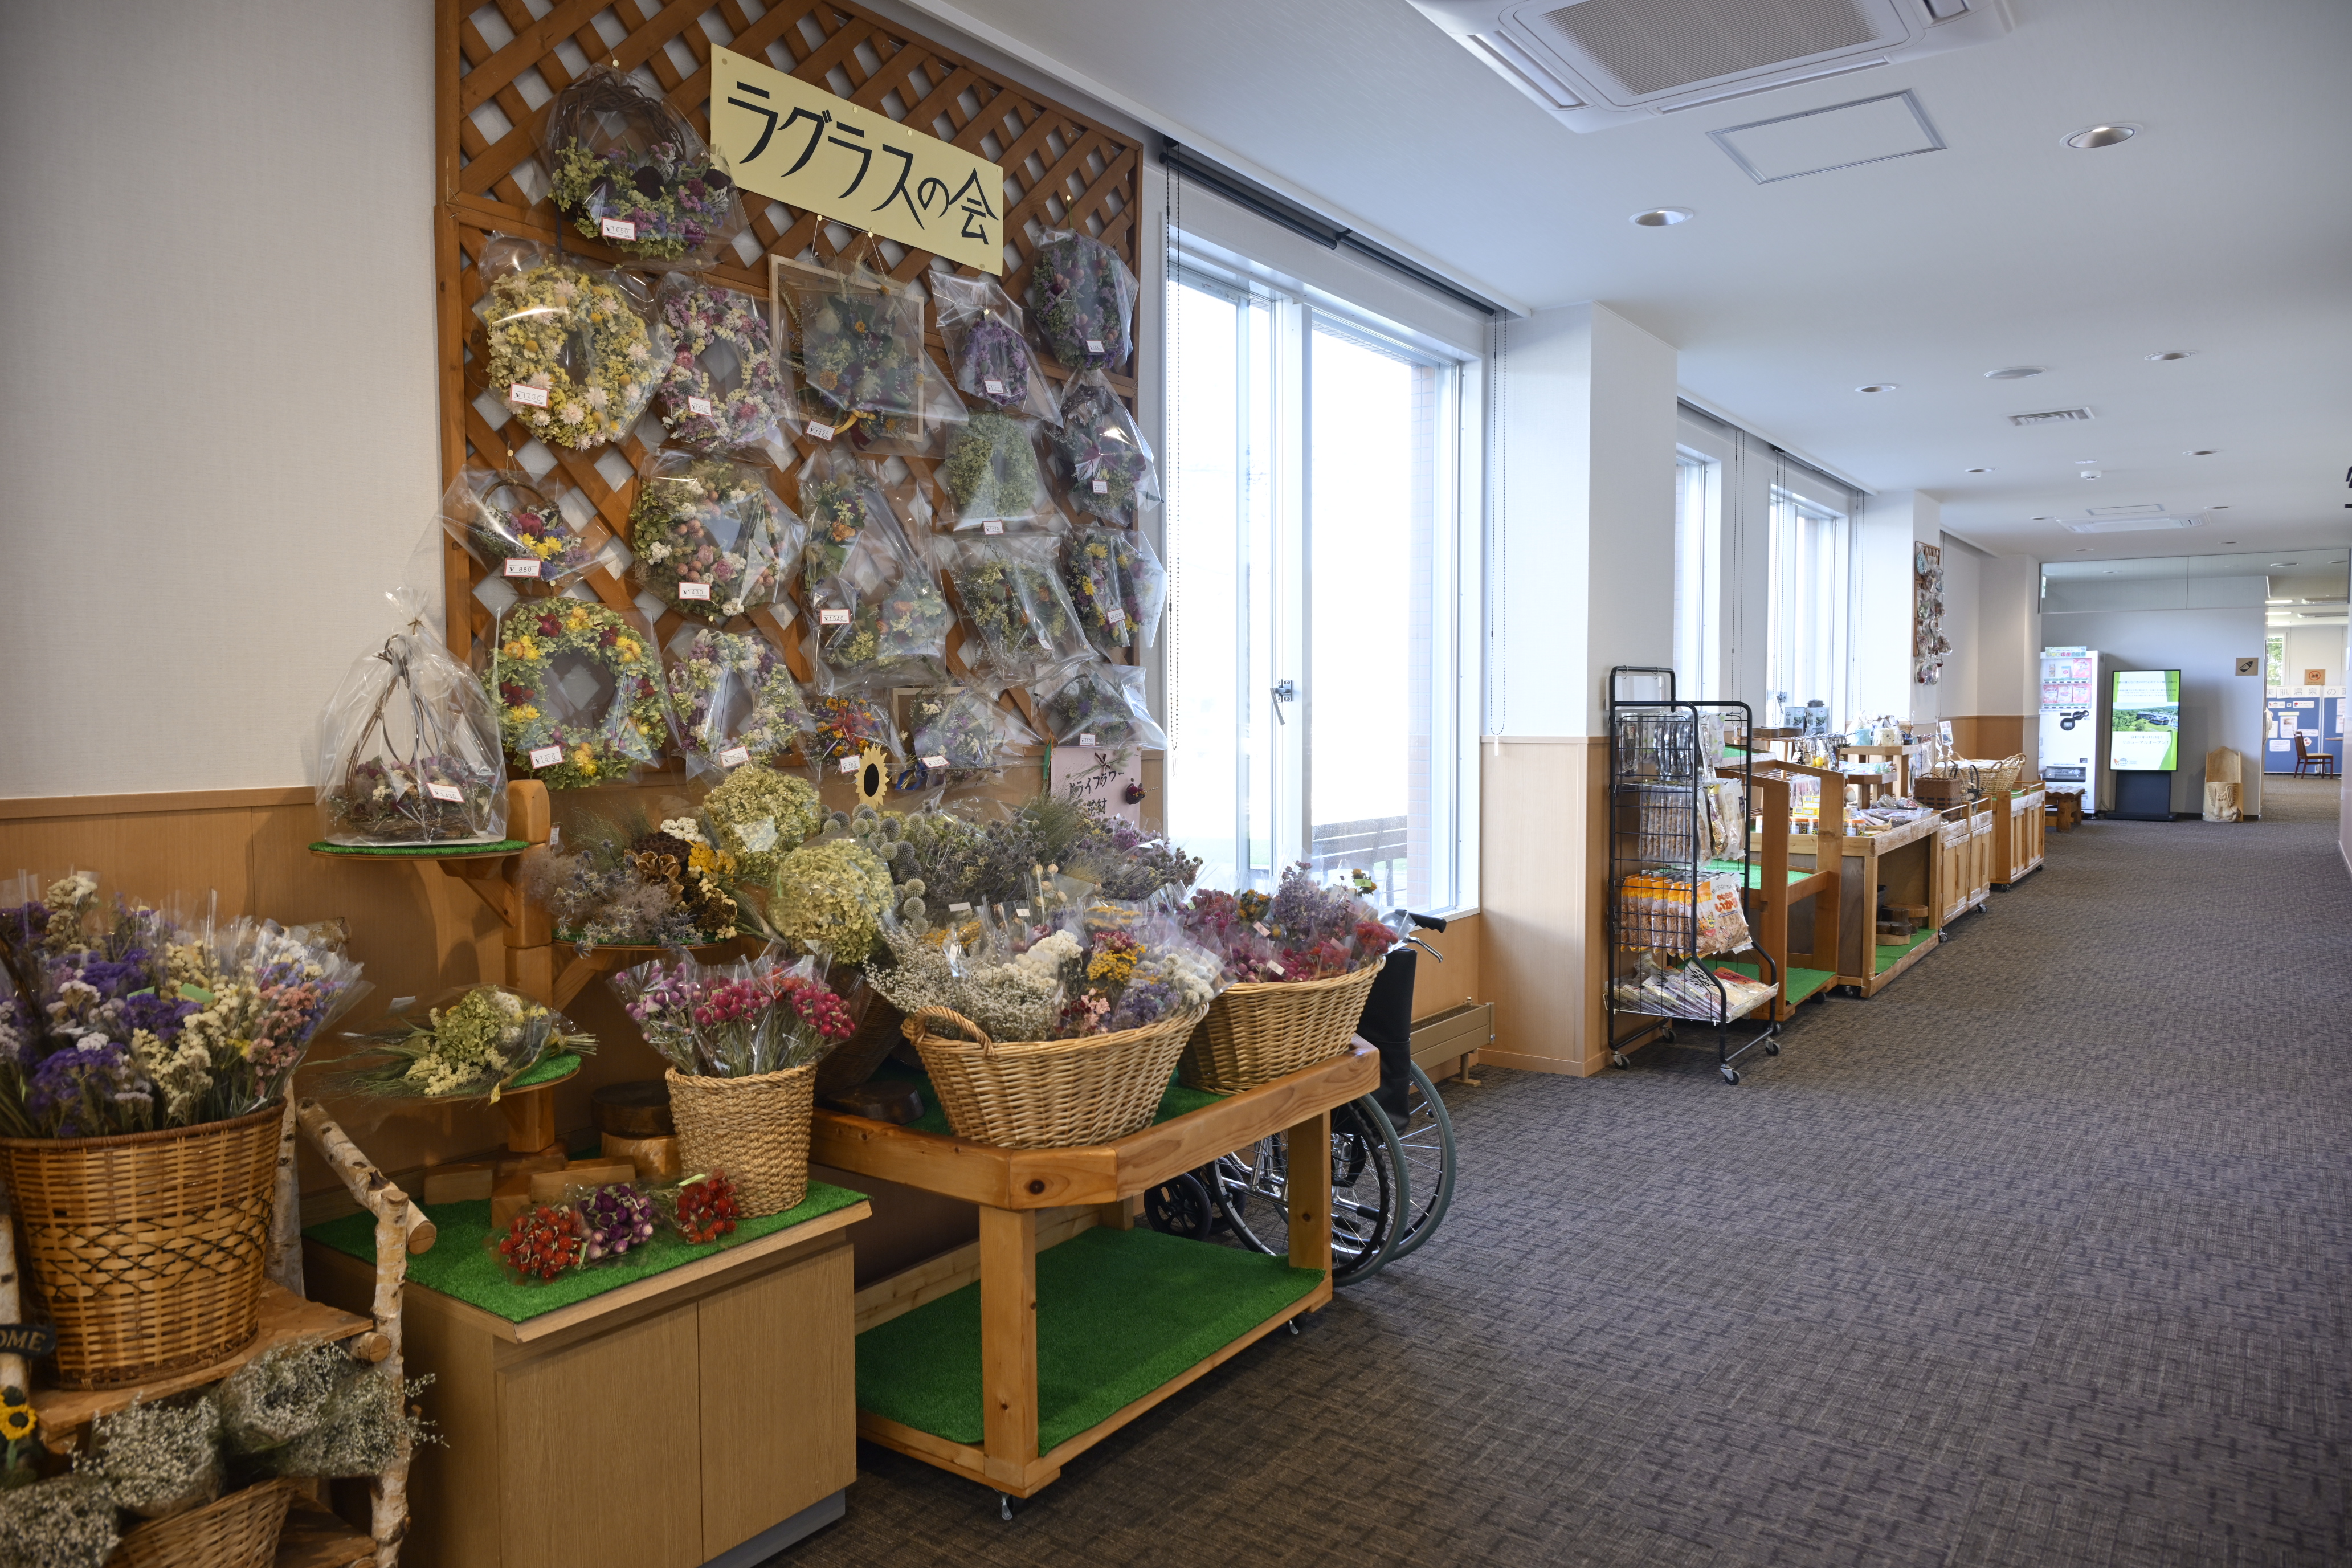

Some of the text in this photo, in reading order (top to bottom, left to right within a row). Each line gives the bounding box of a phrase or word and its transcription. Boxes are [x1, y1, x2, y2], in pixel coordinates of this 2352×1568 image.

[728, 81, 998, 244] ラグラスの会
[516, 393, 541, 401] ¥1430
[810, 428, 828, 438] ¥1430
[536, 754, 556, 763] ¥1870
[434, 790, 457, 799] ¥1430
